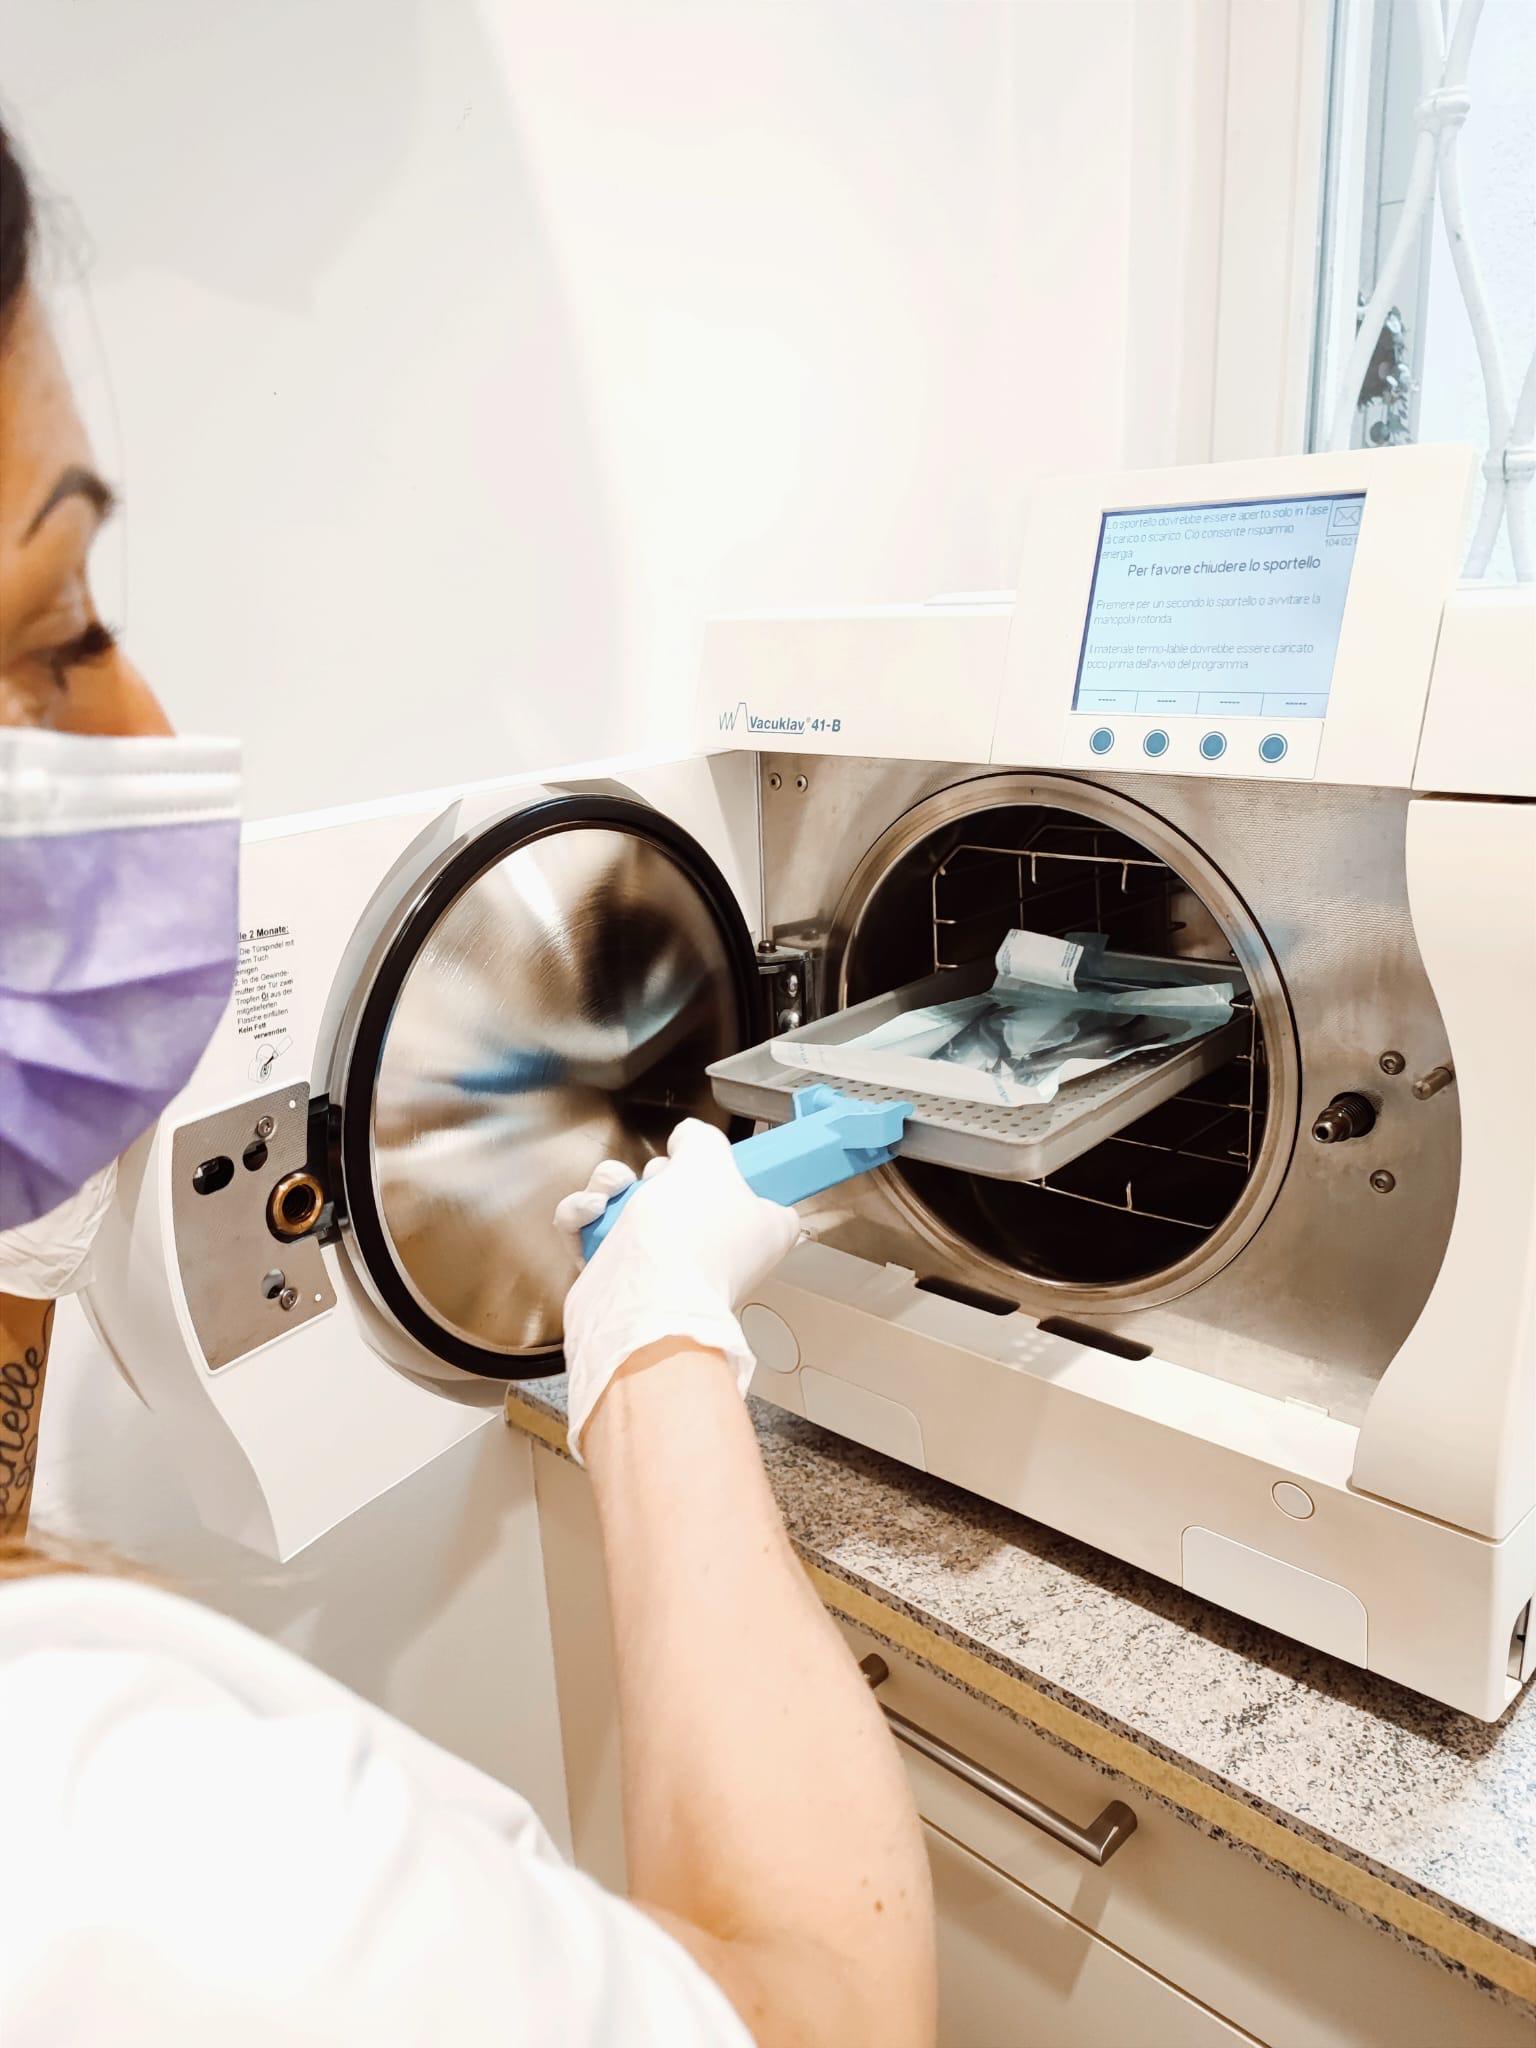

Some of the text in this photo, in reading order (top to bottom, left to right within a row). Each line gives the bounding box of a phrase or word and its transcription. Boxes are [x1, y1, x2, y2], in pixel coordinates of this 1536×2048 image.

[1119, 517, 1157, 530] sportello
[1158, 514, 1202, 526] dovrebbe
[1204, 511, 1236, 522] essere
[1238, 508, 1270, 522] aperto
[1272, 506, 1292, 517] solo
[1295, 507, 1304, 516] in
[1306, 504, 1329, 516] fase
[1112, 535, 1140, 545] carico
[1202, 526, 1246, 538] consente
[1248, 524, 1295, 538] risparmio
[1127, 555, 1322, 578] Per favore chiudere lo sportello
[1096, 592, 1321, 611] Premere per un secondo lo sportello o avvitare la
[1093, 614, 1136, 626] manopola
[1094, 644, 1134, 655] materiale
[1136, 643, 1188, 654] termo-labile
[1190, 643, 1235, 654] dovrebbe
[1236, 644, 1270, 654] essere
[1272, 643, 1314, 654] caricato
[1086, 660, 1108, 670] poco
[1108, 660, 1134, 671] prima
[1177, 658, 1192, 670] del
[810, 718, 842, 733] 41-B
[249, 930, 254, 939] 2
[256, 925, 289, 938] Monate:
[240, 939, 294, 956] Die Türspindel mit
[254, 954, 269, 963] Tuch
[250, 976, 258, 984] die
[260, 970, 290, 980] Gewinde-
[235, 978, 294, 996] mutter der Tür zwei
[236, 995, 260, 1006] Tropfen
[261, 992, 269, 1001] Öl
[282, 988, 292, 996] der
[236, 1002, 278, 1016] mitgelieferten
[238, 1008, 289, 1024] Flasche einfüllen
[238, 1022, 266, 1034] Kein Fett
[254, 1026, 287, 1040] verwenden
